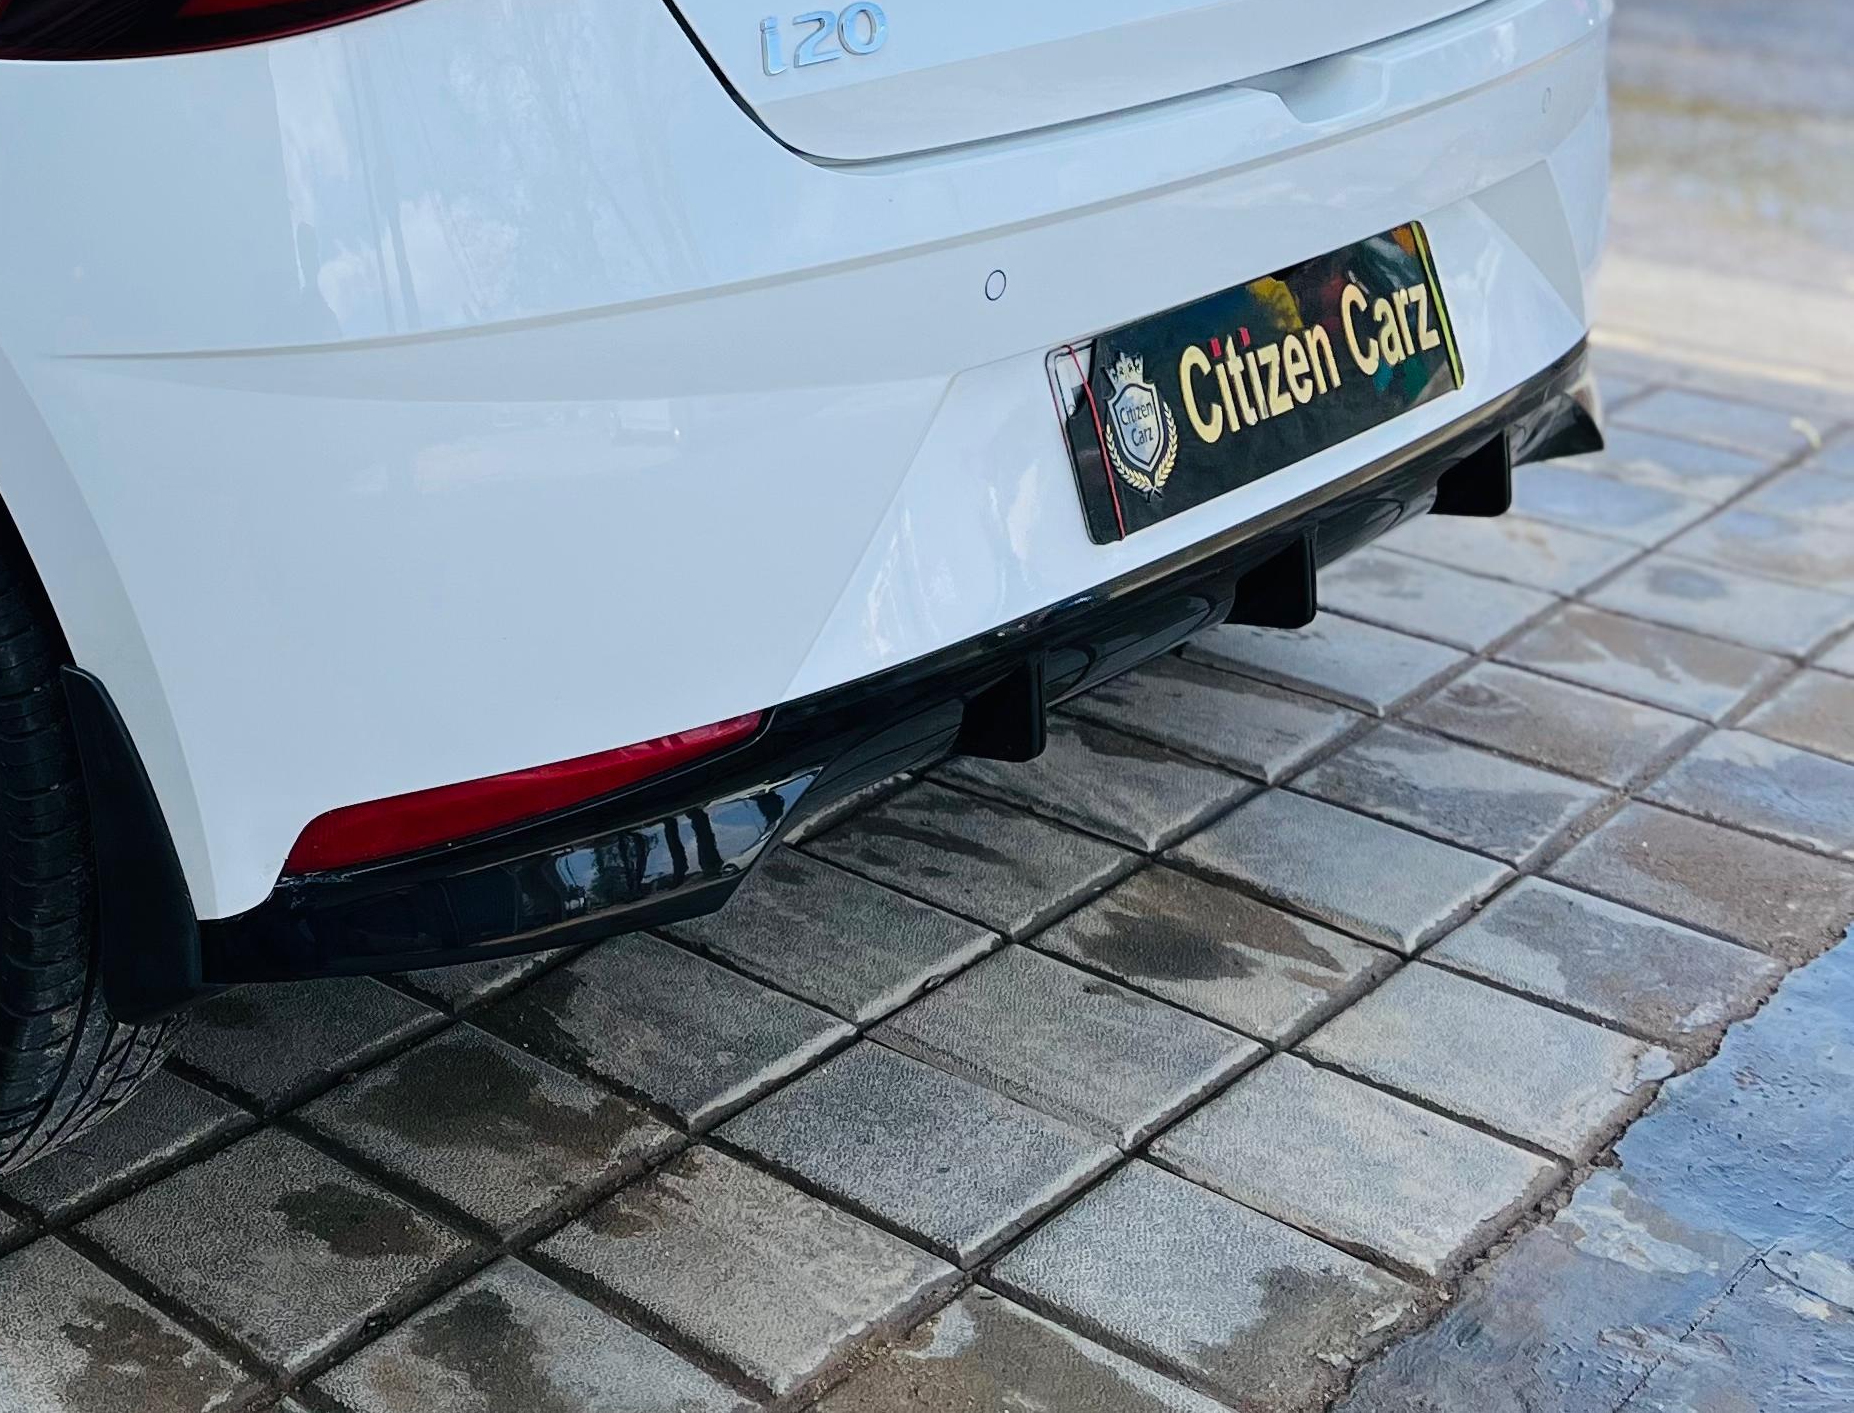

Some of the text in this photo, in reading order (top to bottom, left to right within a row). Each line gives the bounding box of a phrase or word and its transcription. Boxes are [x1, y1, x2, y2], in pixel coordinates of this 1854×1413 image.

[759, 1, 889, 76] i20
[1179, 283, 1441, 444] Citizen Carz
[1119, 400, 1154, 425] Citizen
[1131, 425, 1154, 447] Carz
